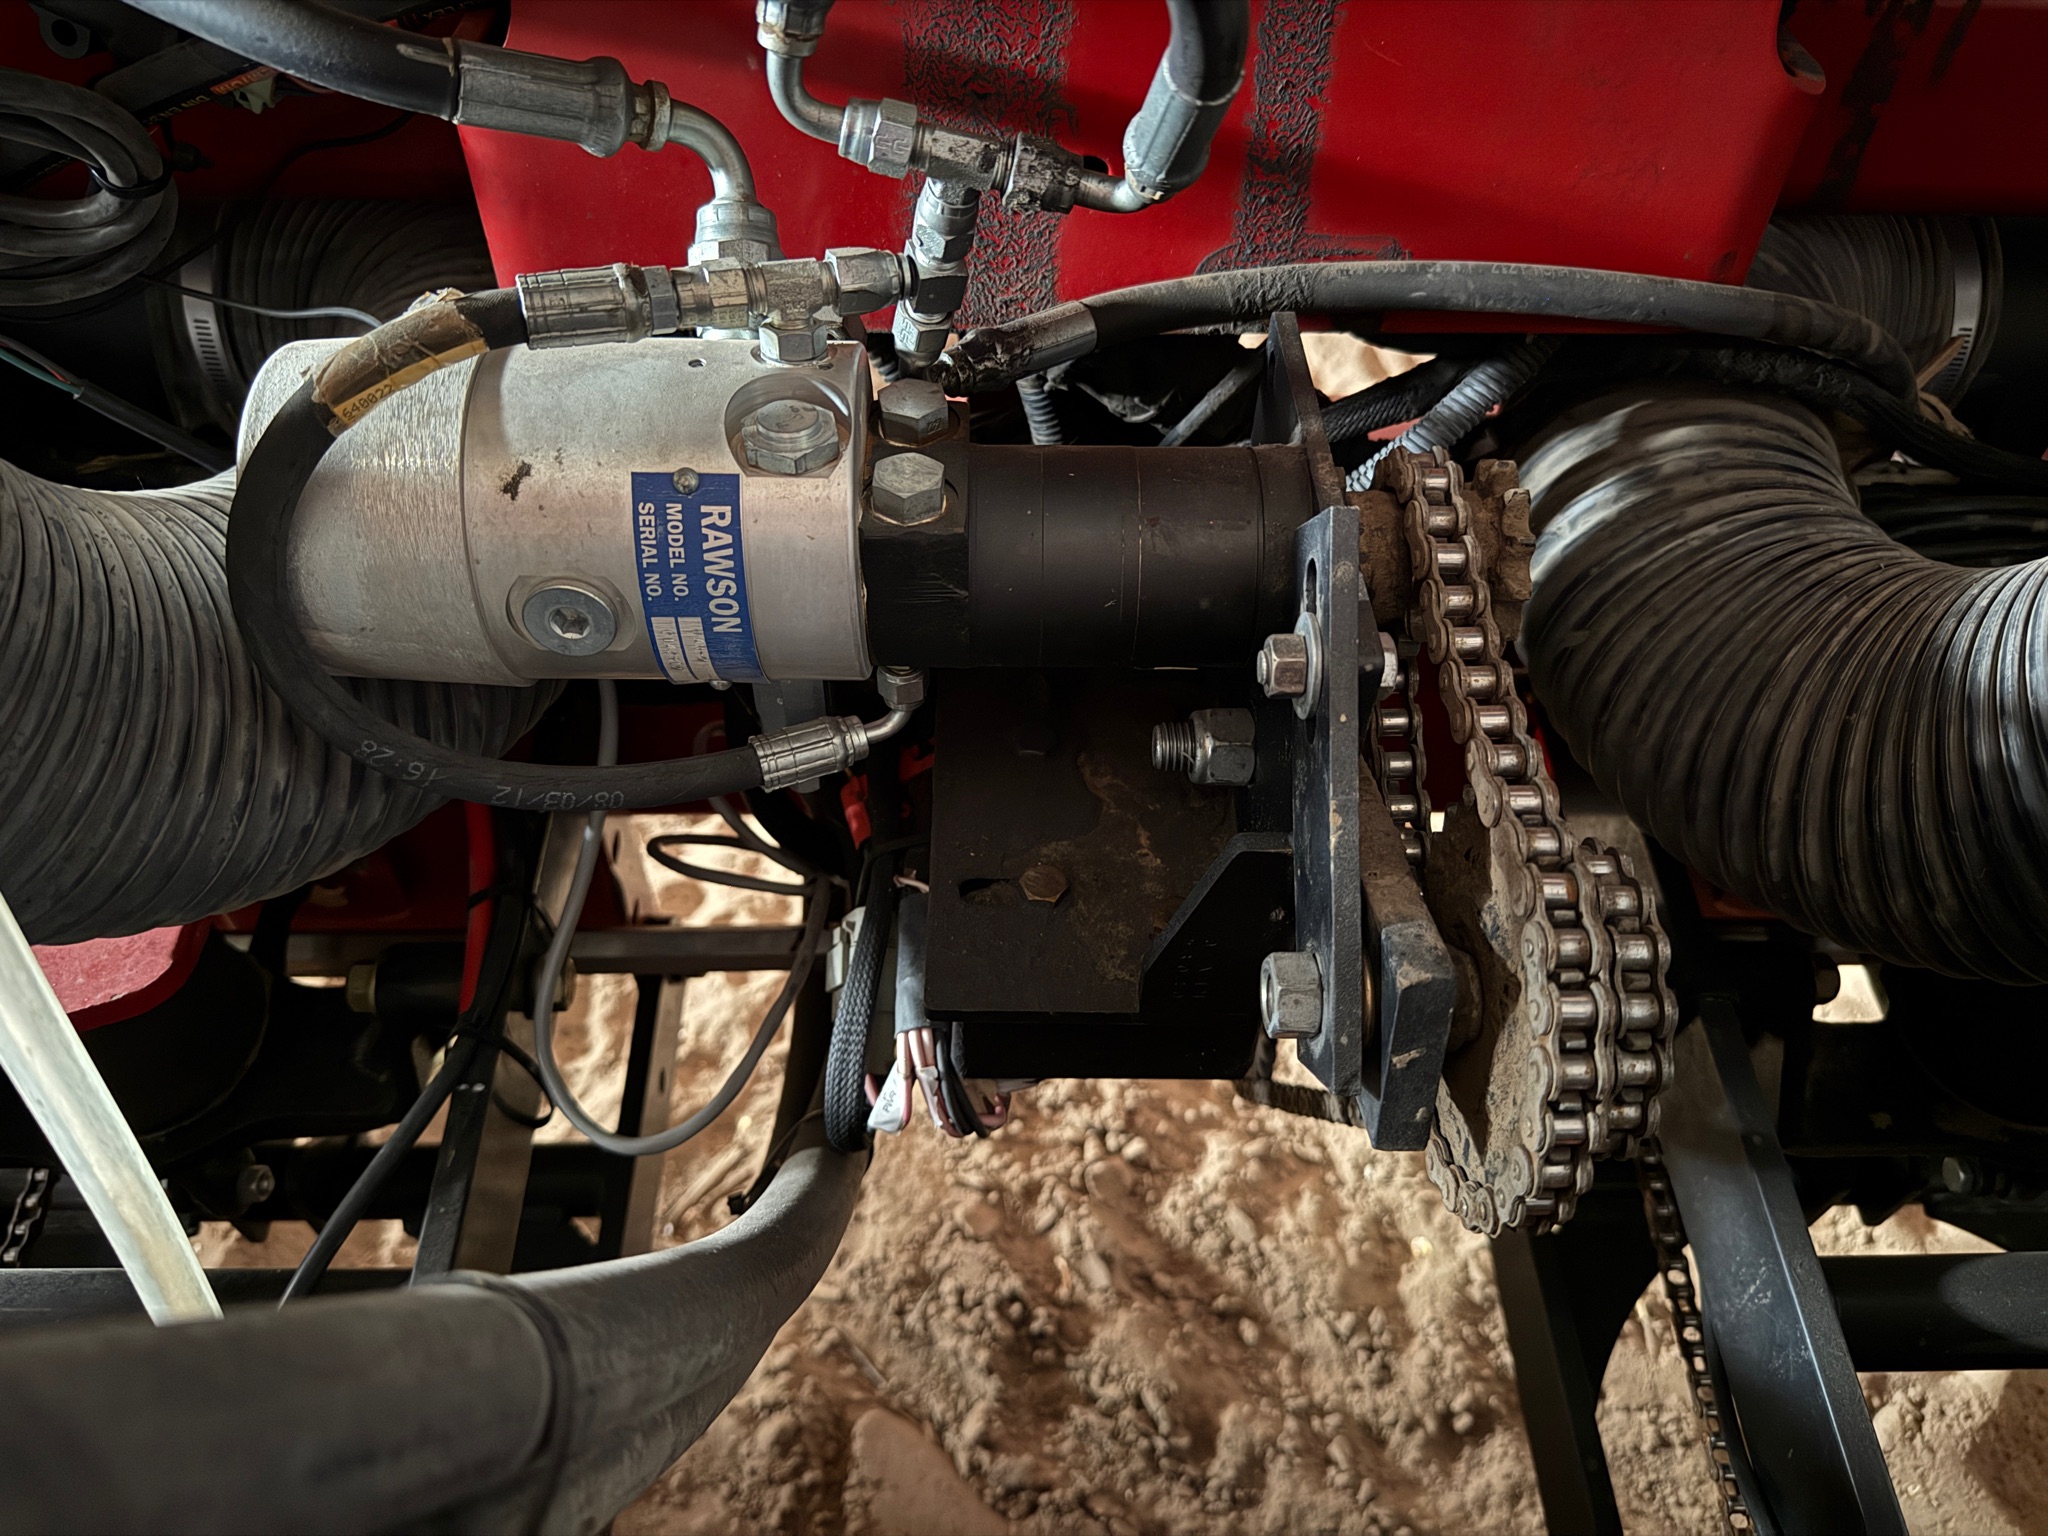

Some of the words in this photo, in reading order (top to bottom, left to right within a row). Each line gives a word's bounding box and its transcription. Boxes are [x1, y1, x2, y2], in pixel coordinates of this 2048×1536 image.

[638, 501, 659, 568] SERIAL
[666, 503, 686, 568] MODEL
[644, 573, 663, 602] NO.
[671, 573, 689, 602] NO.
[700, 505, 743, 633] RAWSON
[355, 739, 440, 788] 16:28
[491, 785, 625, 812] 08/03/12
